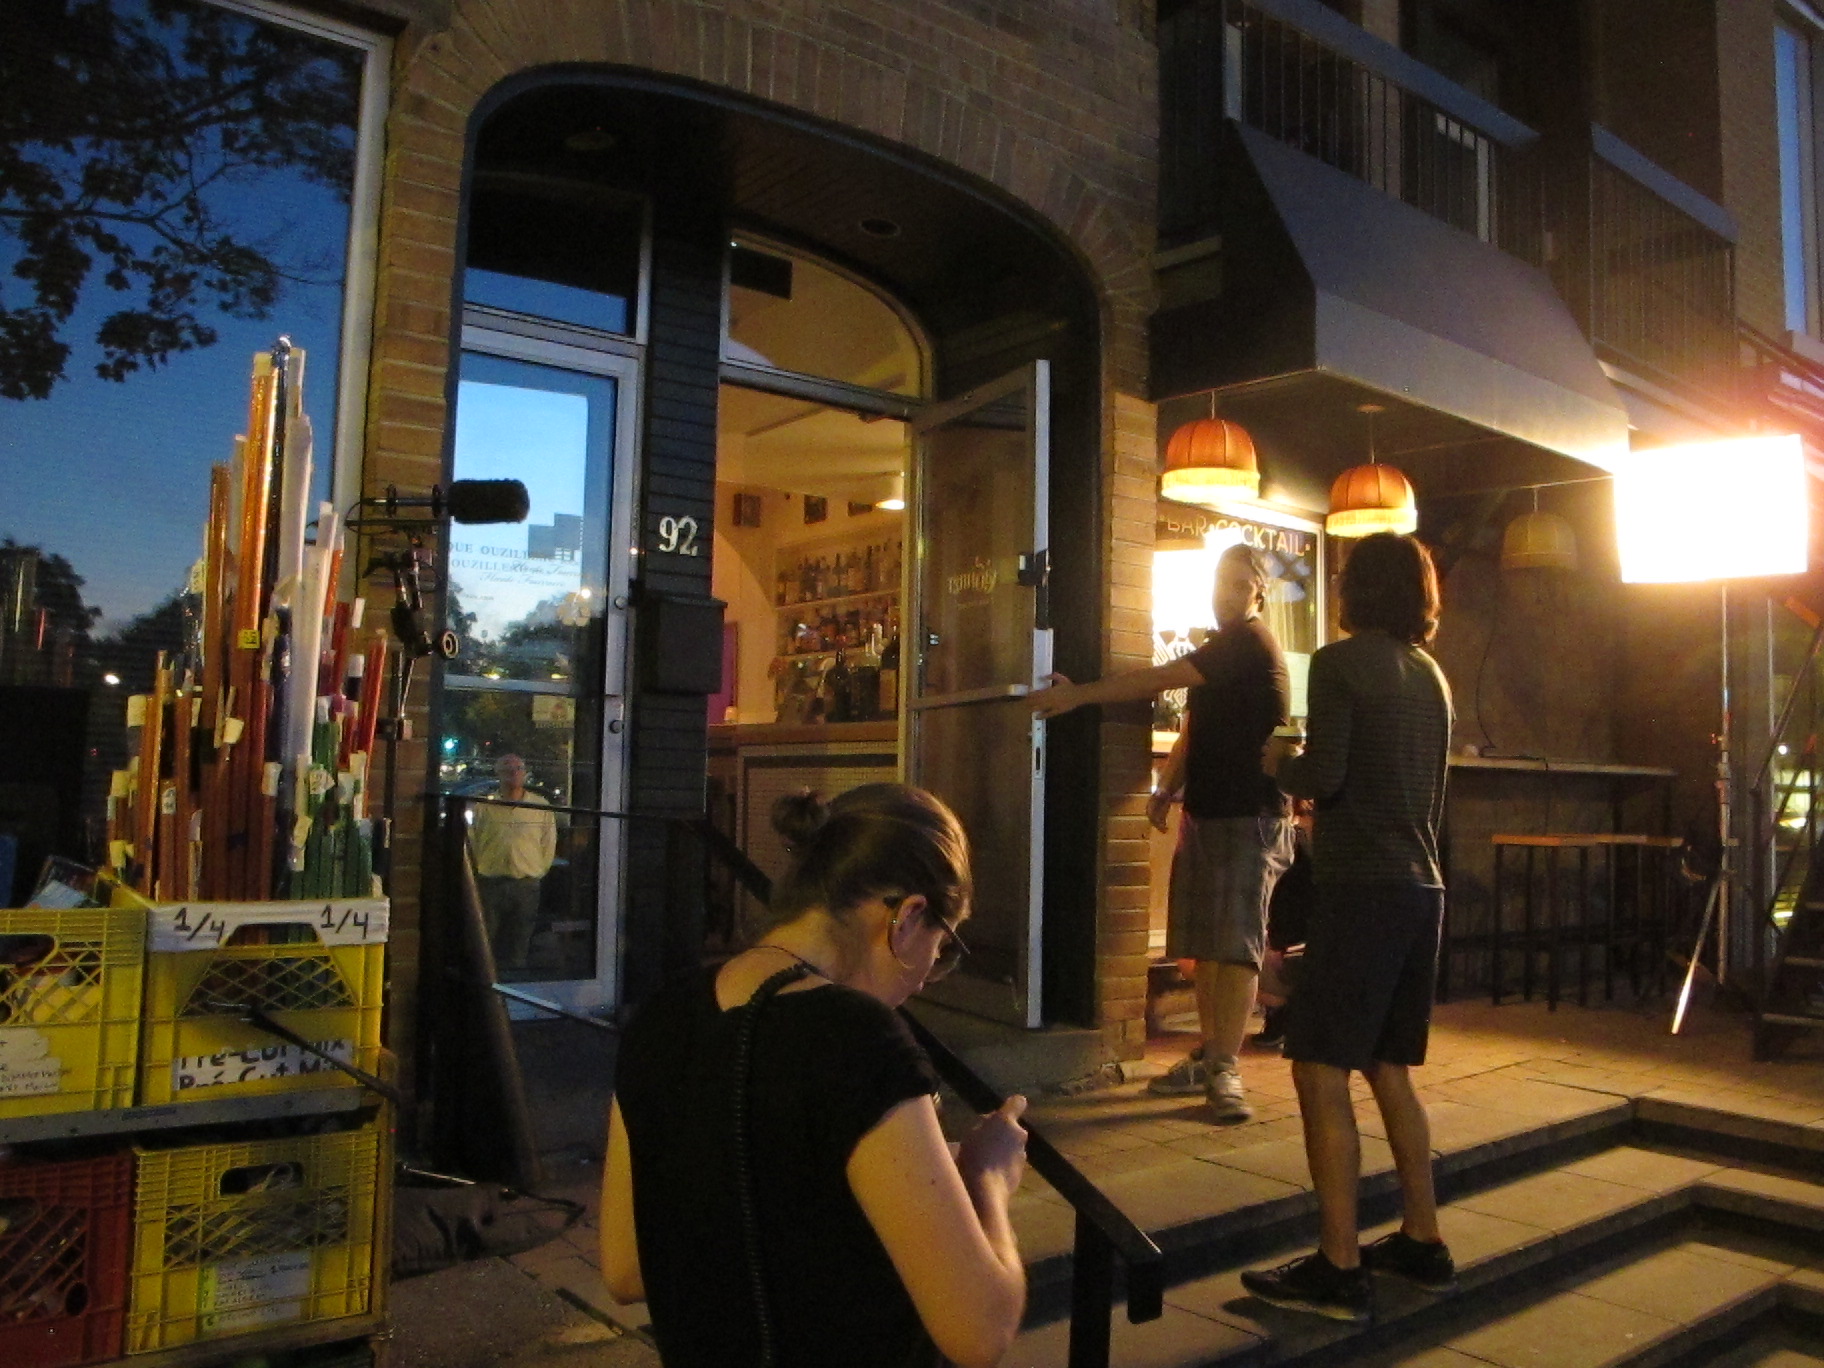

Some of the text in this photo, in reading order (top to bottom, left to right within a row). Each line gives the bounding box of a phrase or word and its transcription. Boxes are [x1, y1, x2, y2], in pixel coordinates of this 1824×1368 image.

[658, 515, 698, 557] 92
[1167, 515, 1208, 538] BAR
[450, 542, 473, 554] UE
[173, 907, 225, 943] 1/4
[321, 905, 370, 940] 1/4
